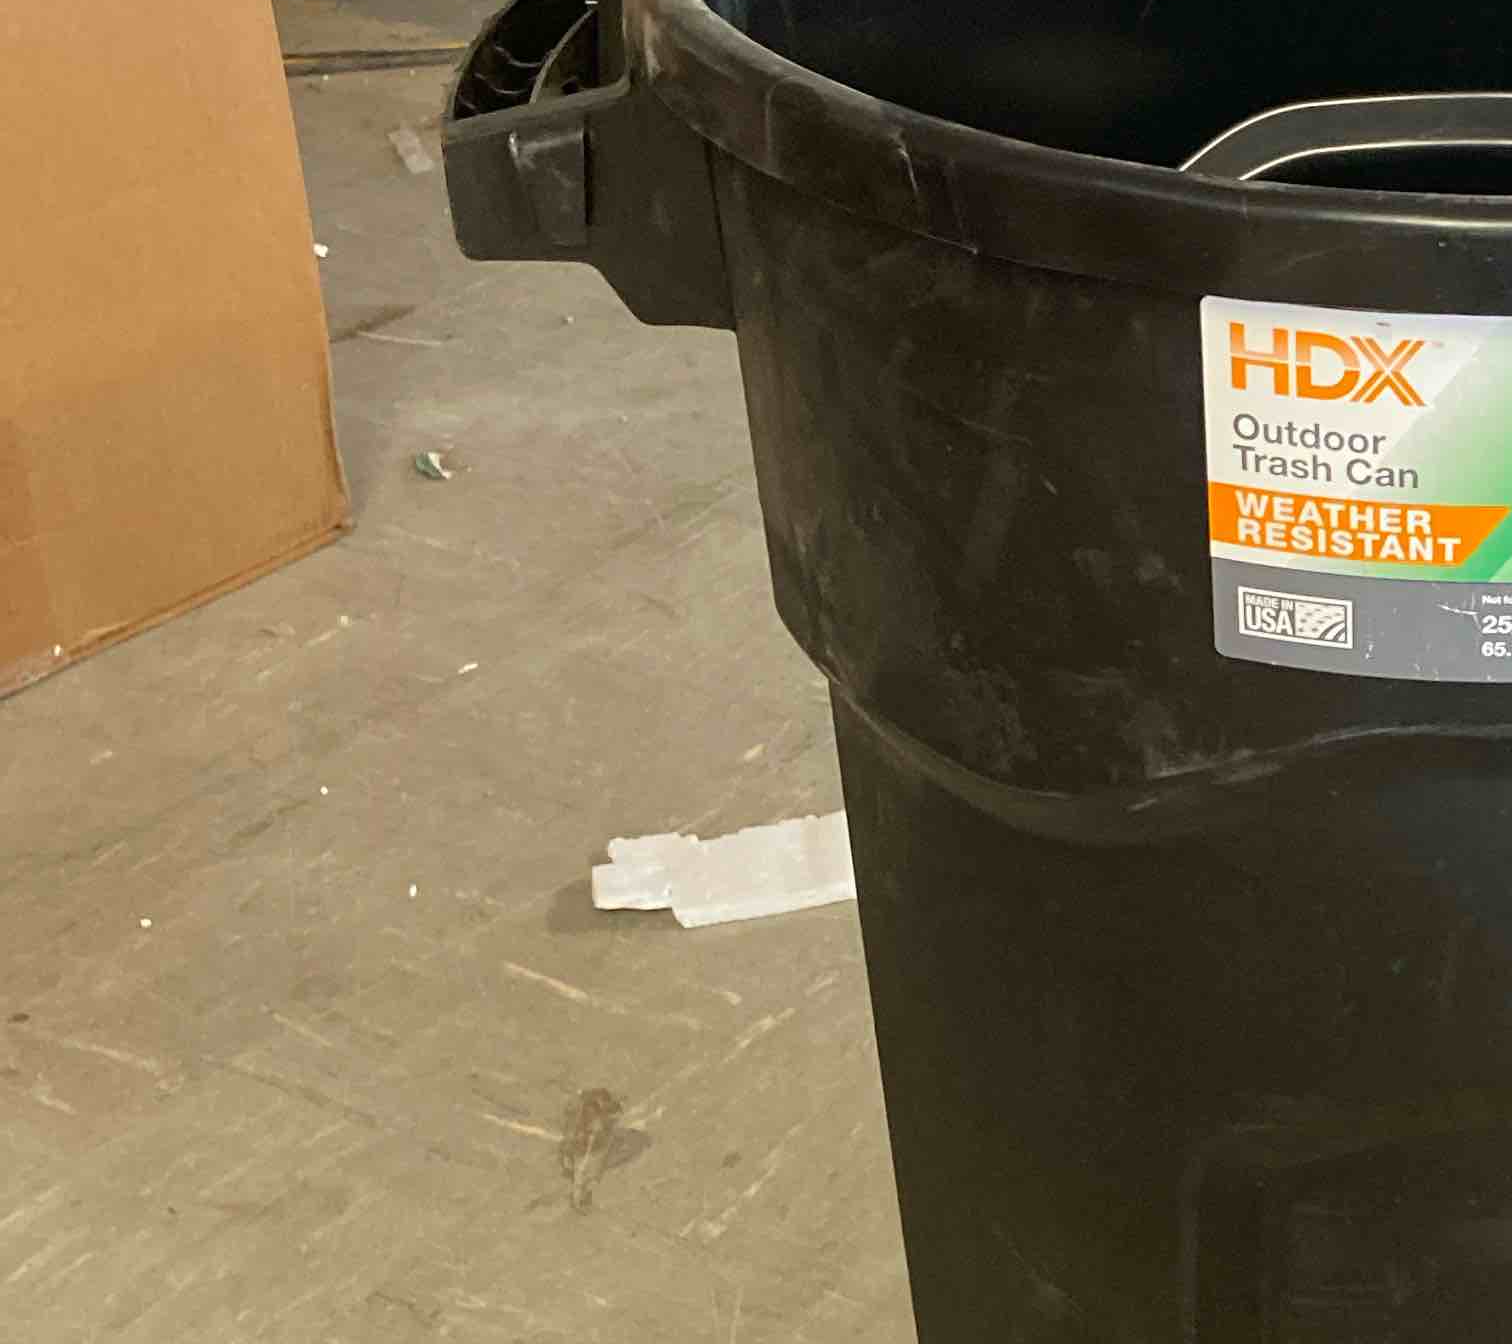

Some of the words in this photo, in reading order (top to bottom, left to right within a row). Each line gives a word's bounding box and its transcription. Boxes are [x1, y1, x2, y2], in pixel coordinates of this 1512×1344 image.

[1229, 320, 1426, 408] HDX
[1233, 413, 1387, 455] Outdoor
[1233, 444, 1332, 483] Trash
[1346, 458, 1419, 489] Can
[1235, 490, 1432, 535] WEATHER
[1236, 518, 1462, 562] RESISTANT
[1245, 592, 1280, 609] MADE
[1281, 598, 1296, 611] IN
[1245, 606, 1296, 635] USA
[1482, 594, 1501, 606] Not
